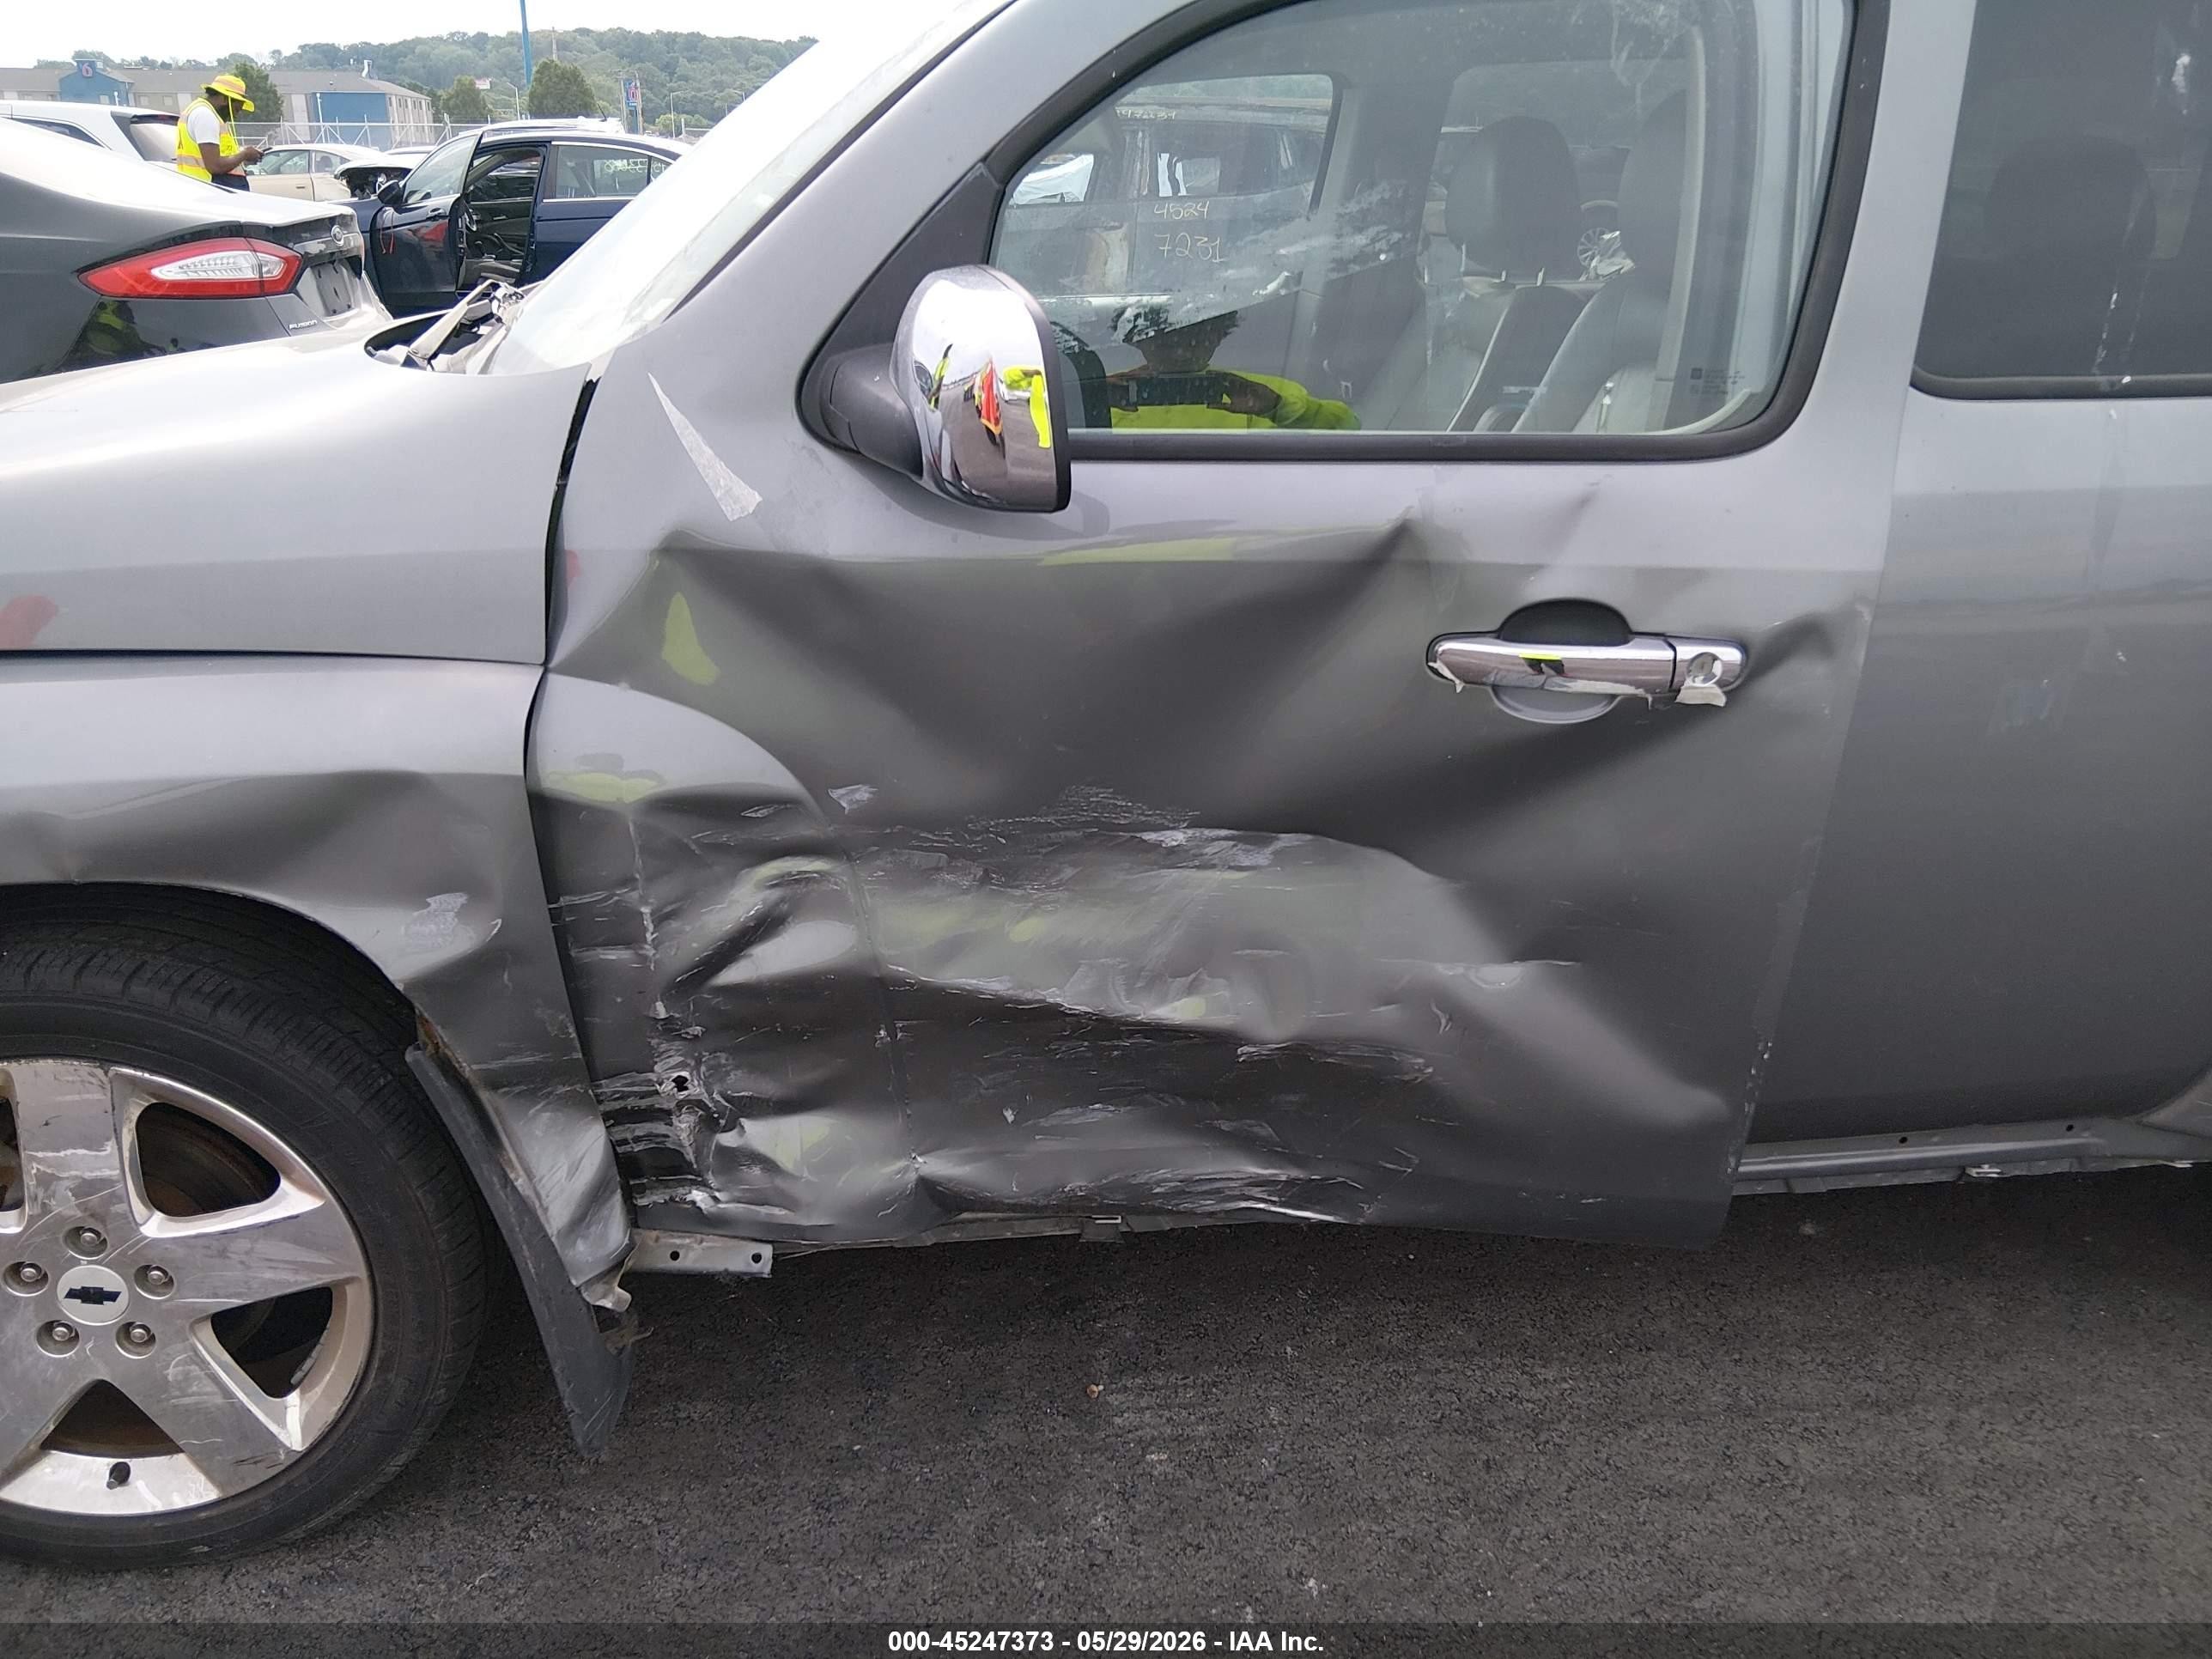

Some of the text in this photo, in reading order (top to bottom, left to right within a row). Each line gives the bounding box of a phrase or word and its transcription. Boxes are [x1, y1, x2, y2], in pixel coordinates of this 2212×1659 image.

[82, 62, 93, 76] 6
[1153, 200, 1210, 220] 4524
[1153, 232, 1225, 263] 7231
